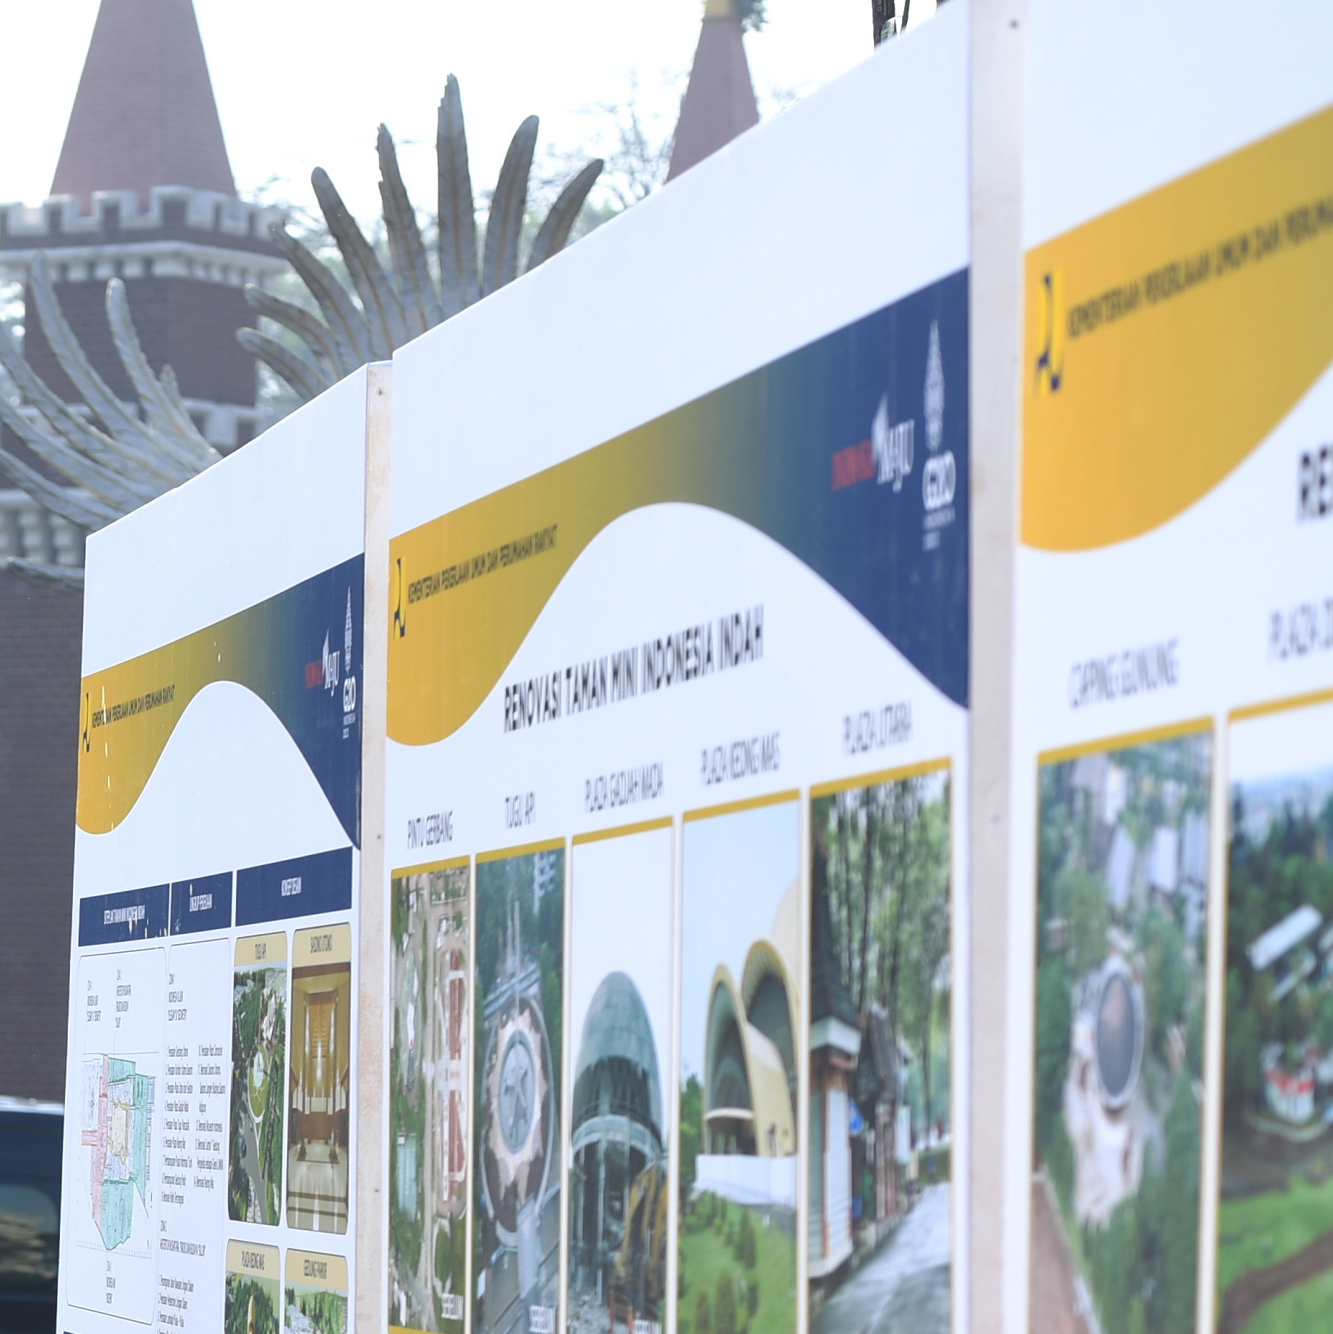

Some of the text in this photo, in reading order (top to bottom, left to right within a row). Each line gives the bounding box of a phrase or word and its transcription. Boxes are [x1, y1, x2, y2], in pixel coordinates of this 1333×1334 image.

[504, 602, 764, 733] RENOVASI TAMAN MINI INDONESIA INDAH
